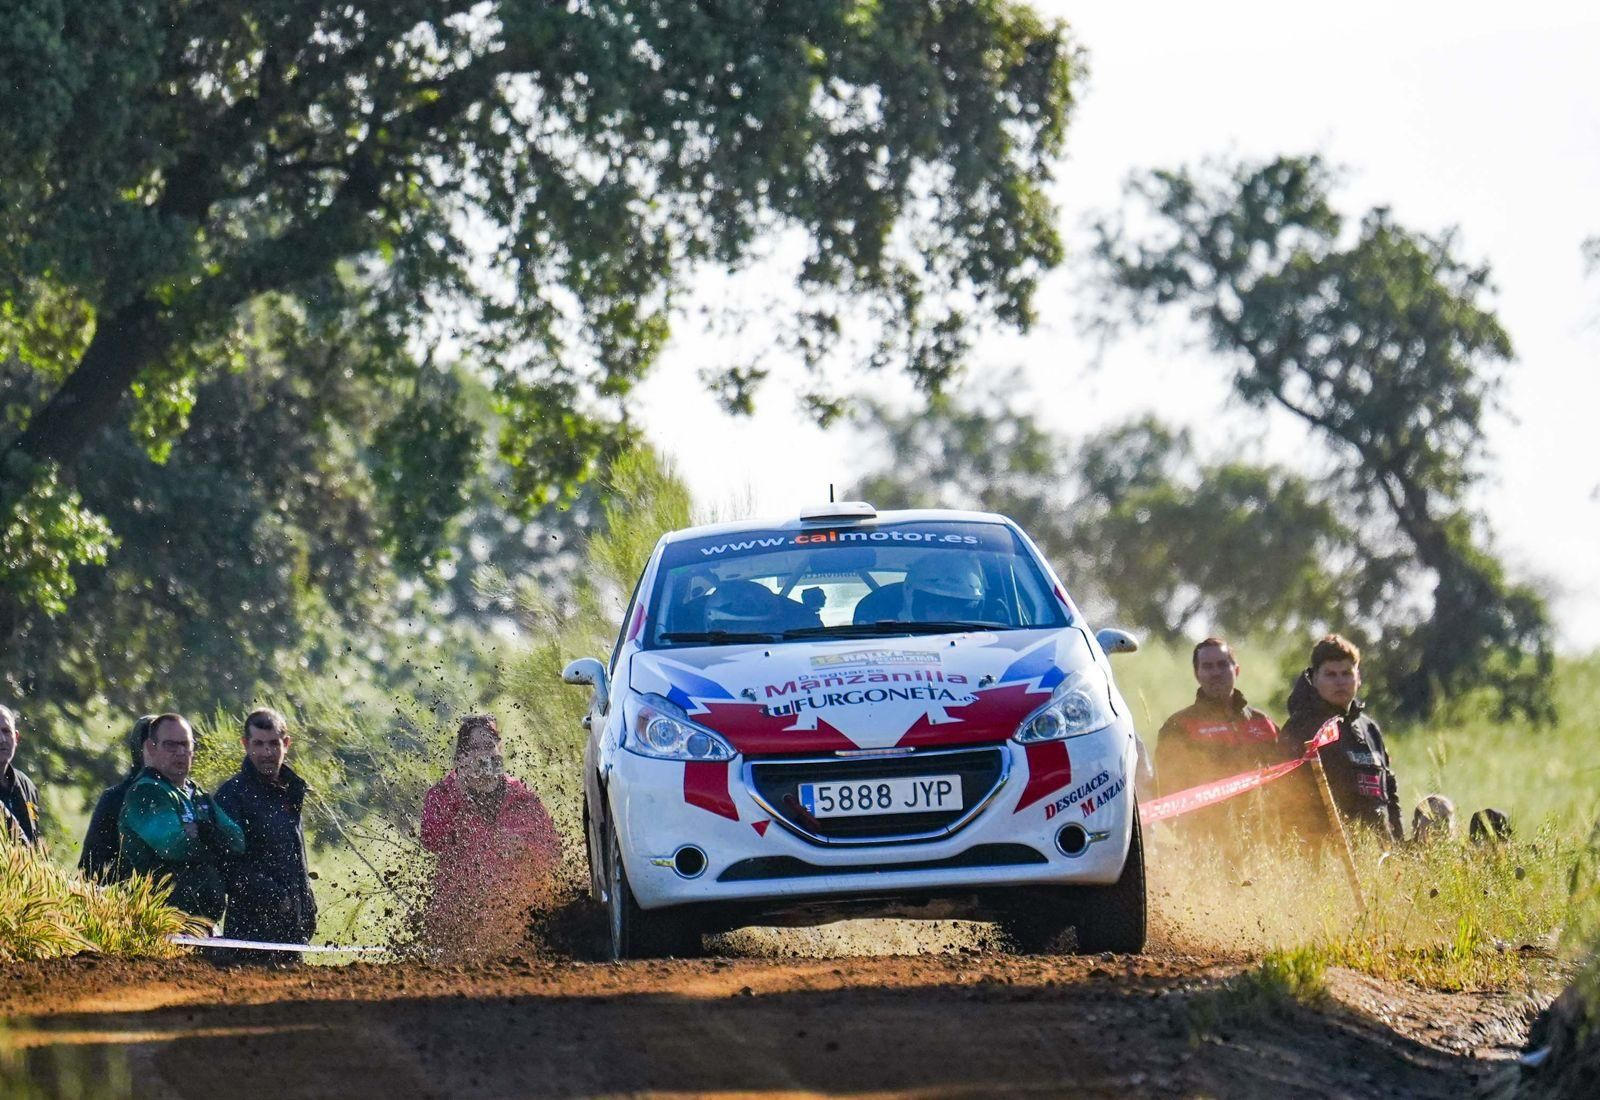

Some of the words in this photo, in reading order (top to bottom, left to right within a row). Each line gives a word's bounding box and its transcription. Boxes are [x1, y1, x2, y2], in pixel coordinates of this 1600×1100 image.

[701, 530, 977, 556] www.calmotor.es
[765, 670, 968, 698] Manzanilla
[798, 668, 884, 682] Desguaces
[818, 783, 893, 812] 5888
[903, 780, 953, 808] JYP
[1045, 769, 1110, 821] DESGUACES
